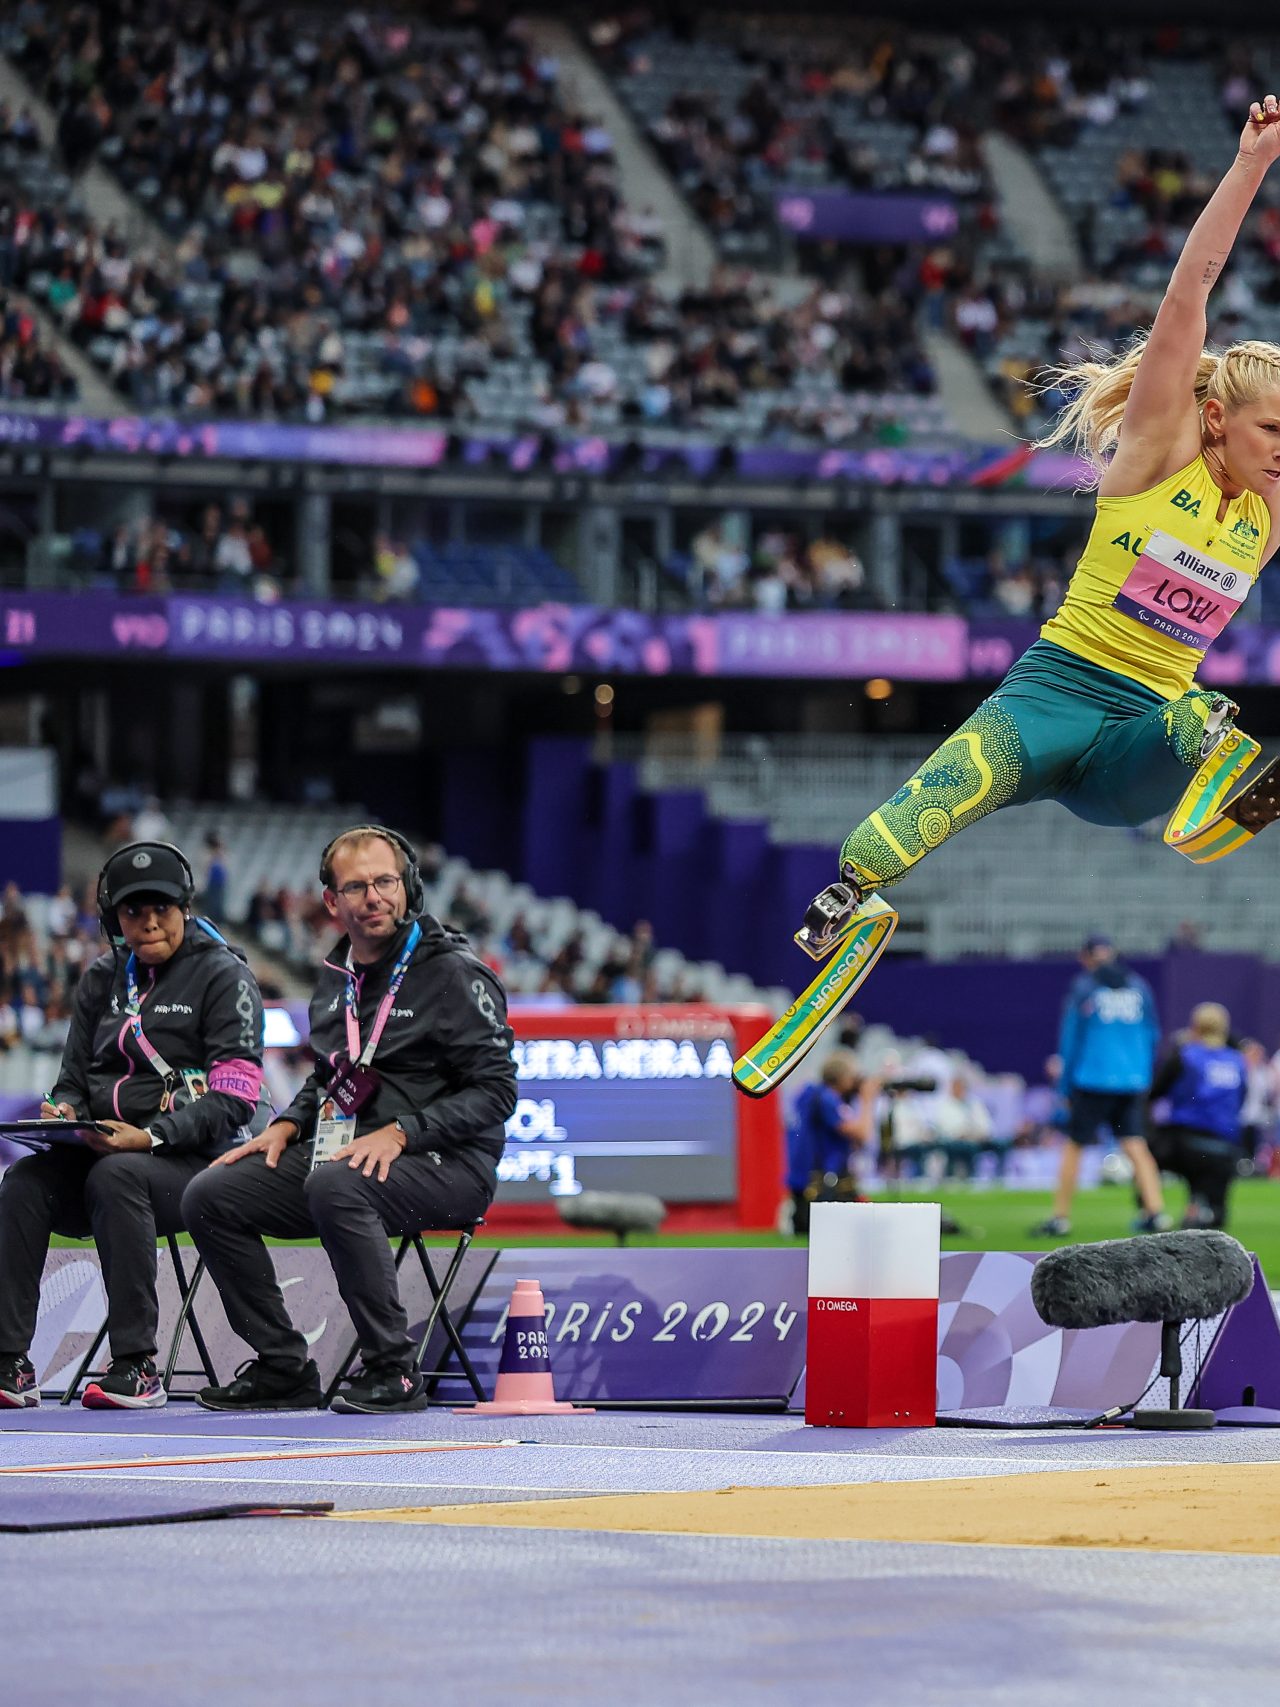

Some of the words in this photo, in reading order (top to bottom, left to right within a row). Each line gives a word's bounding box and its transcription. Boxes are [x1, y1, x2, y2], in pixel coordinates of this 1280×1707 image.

[1111, 531, 1143, 557] AU
[1173, 549, 1222, 582] Allianz
[1152, 578, 1220, 624] LOW
[181, 606, 295, 648] PARIS
[303, 610, 403, 652] 2024
[1153, 618, 1181, 637] PARIS
[505, 1098, 569, 1143] OL
[826, 1300, 858, 1311] OMEGA
[652, 1302, 798, 1343] 2024
[517, 1331, 548, 1345] PARI
[518, 1345, 549, 1359] 202
